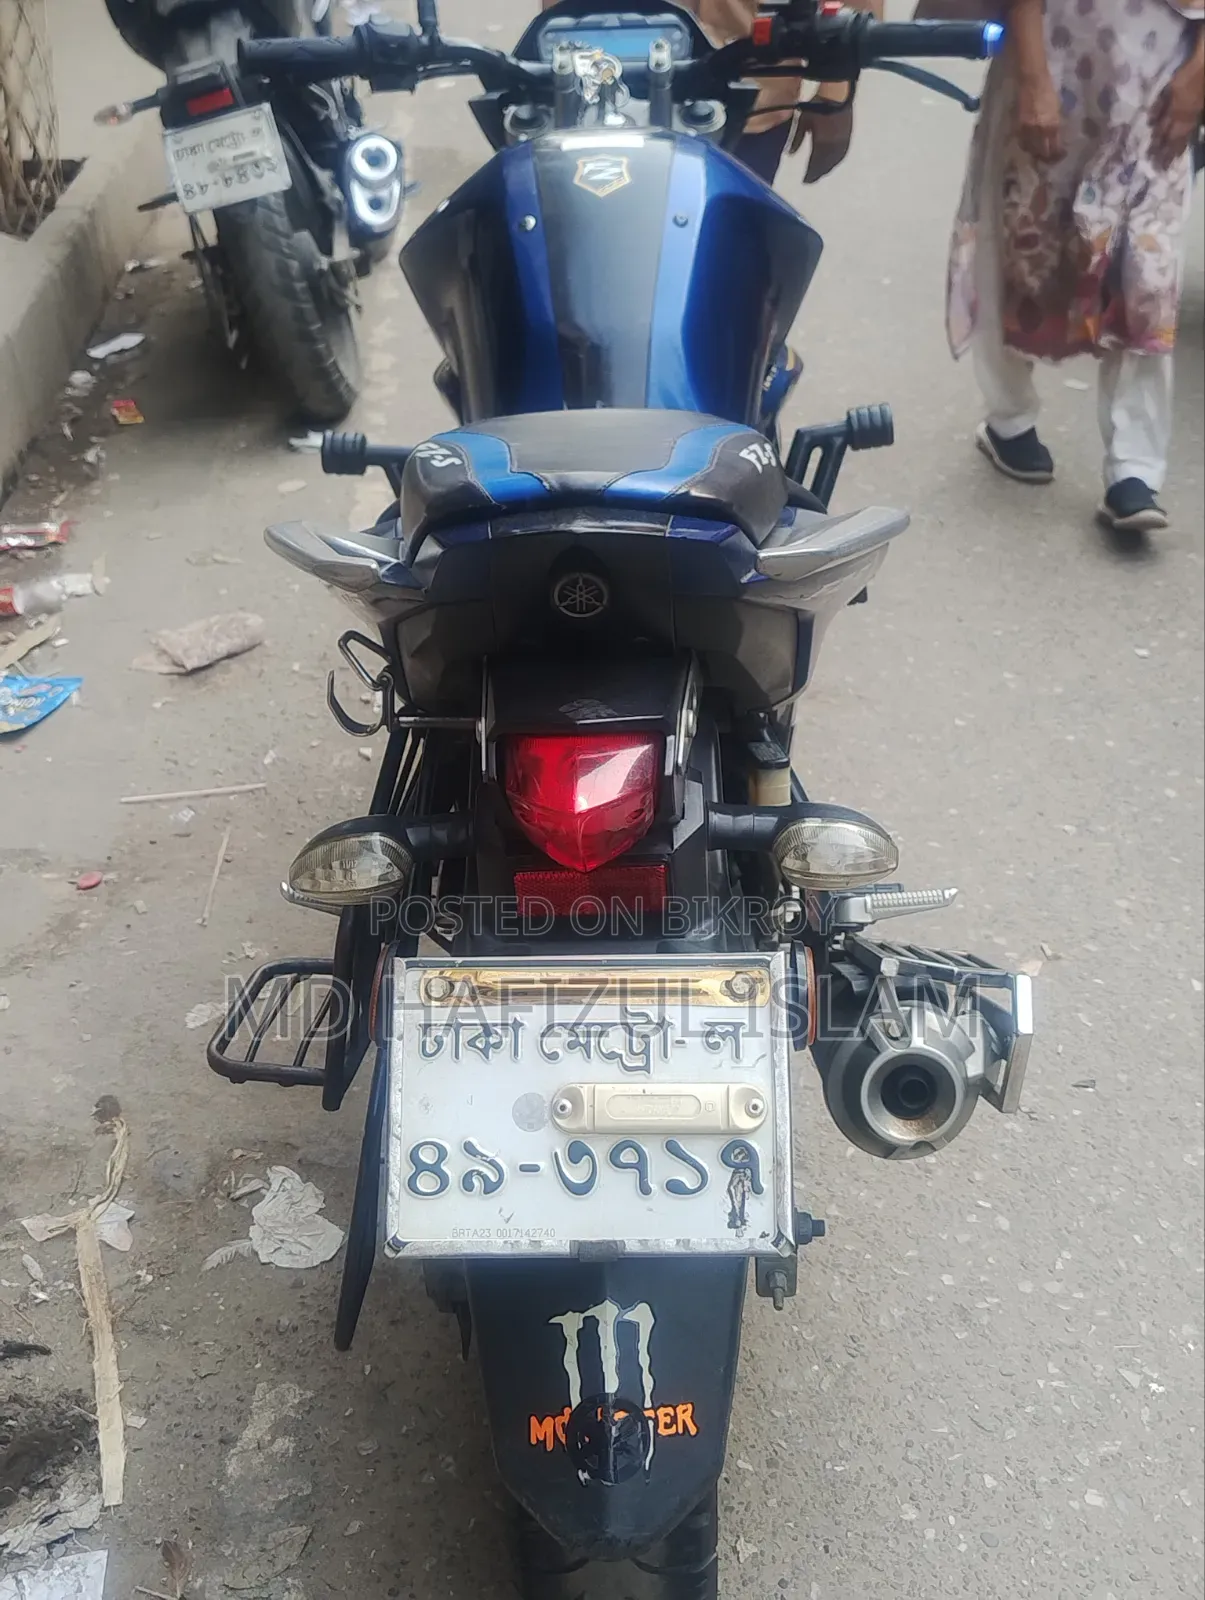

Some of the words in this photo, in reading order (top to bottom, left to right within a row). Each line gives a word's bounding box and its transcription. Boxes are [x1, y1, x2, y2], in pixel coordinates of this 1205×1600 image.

[417, 1014, 528, 1062] ঢাকা
[405, 1137, 765, 1199] ৪৯-৩৭১৭
[451, 1228, 492, 1238] BRTA23
[496, 1228, 556, 1238] 0017142740
